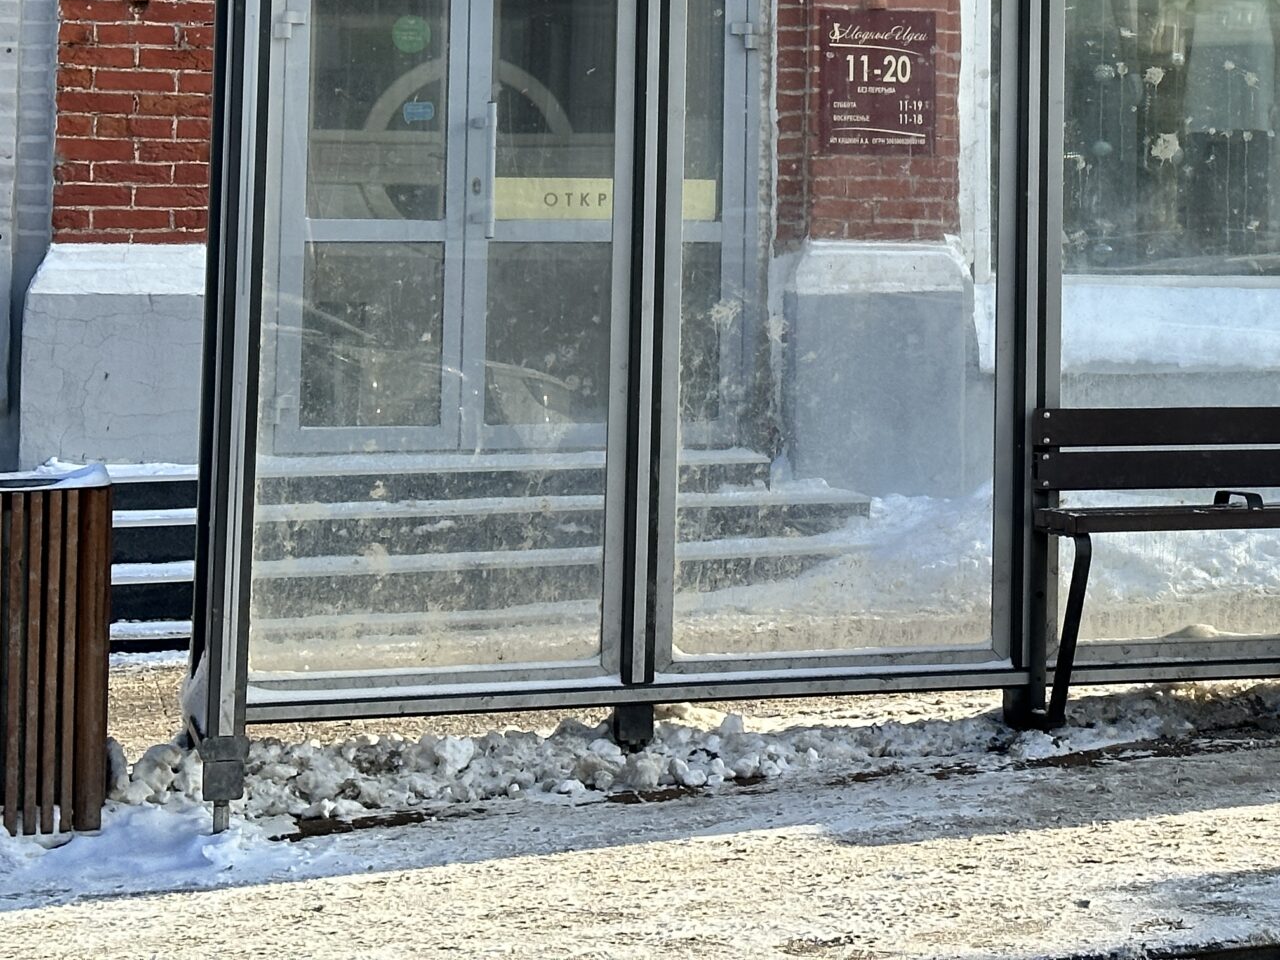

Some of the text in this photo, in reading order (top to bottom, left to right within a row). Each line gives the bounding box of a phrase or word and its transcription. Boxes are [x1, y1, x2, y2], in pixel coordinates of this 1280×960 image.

[846, 54, 911, 83] 11-20
[898, 100, 923, 111] 11-19
[898, 113, 923, 125] 11-18
